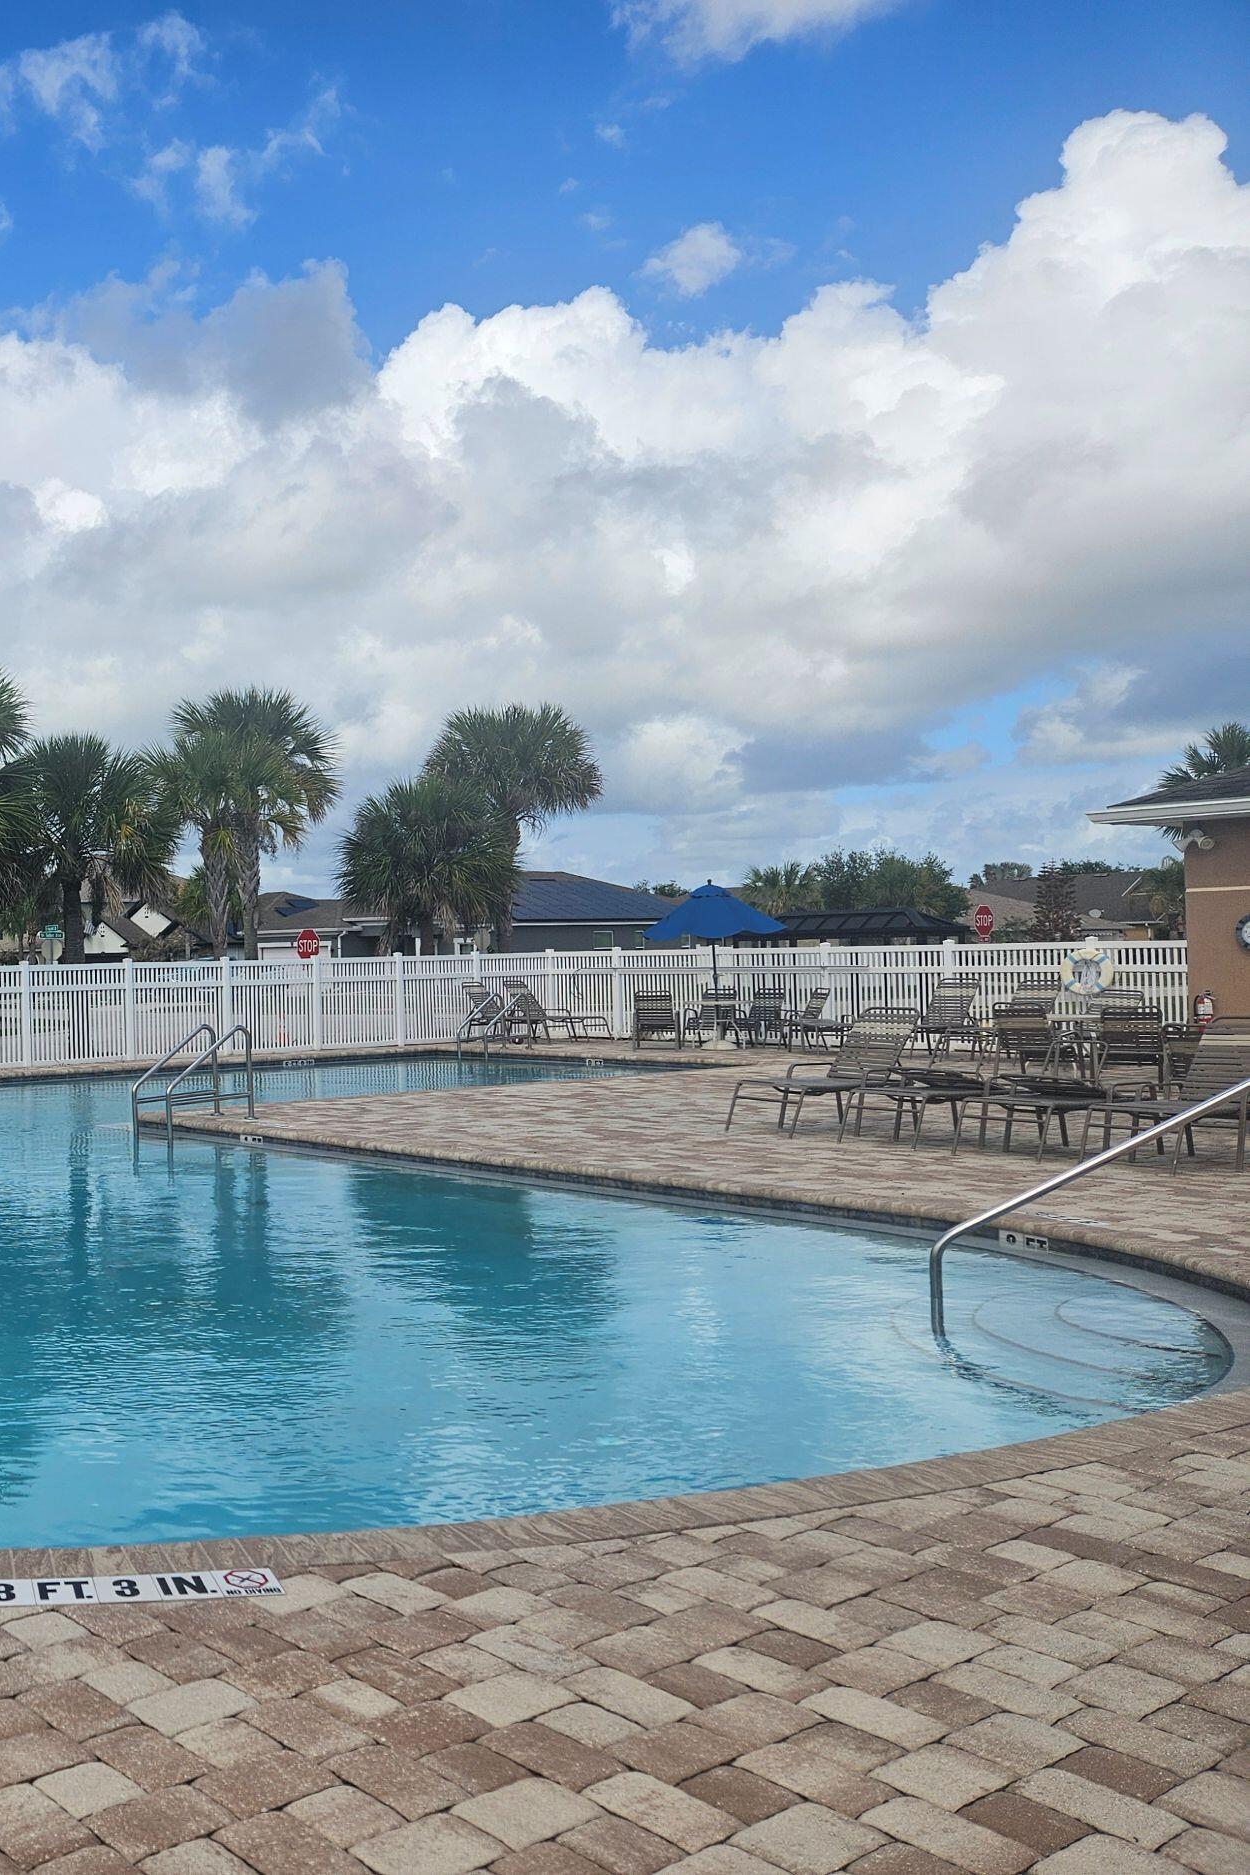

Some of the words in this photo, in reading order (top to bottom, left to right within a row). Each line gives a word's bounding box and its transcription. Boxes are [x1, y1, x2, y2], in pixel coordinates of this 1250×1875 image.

[975, 915, 993, 927] STOP
[298, 939, 319, 953] STOP
[37, 1580, 93, 1601] FT.
[115, 1579, 141, 1598] 3
[155, 1575, 218, 1597] IN.
[244, 1587, 282, 1595] DIVING
